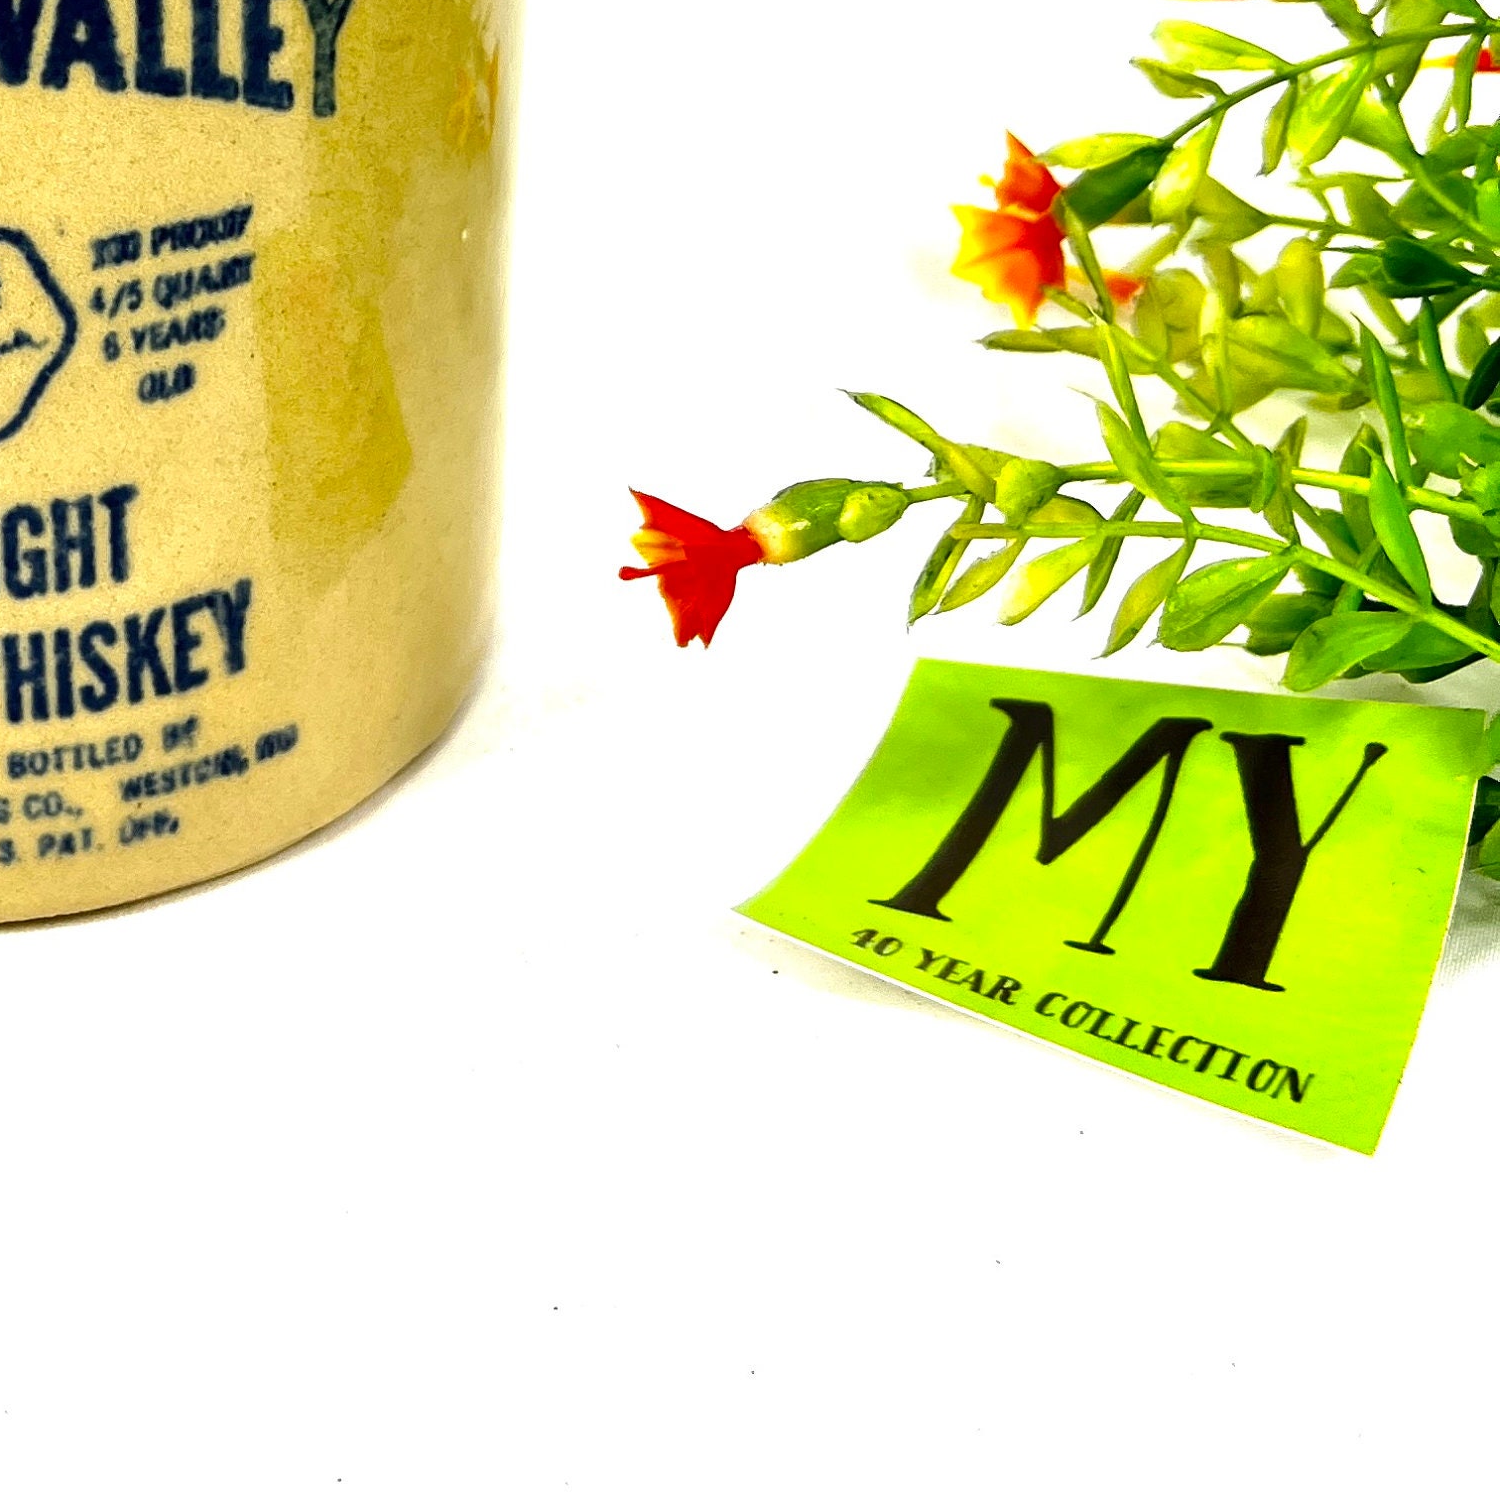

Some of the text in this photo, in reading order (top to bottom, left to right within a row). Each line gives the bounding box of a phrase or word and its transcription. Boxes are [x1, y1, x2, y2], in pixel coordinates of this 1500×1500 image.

[7, 732, 144, 780] BOTTLED
[867, 698, 1389, 993] MY
[850, 927, 1316, 1105] 40 YEAR COLLECTION
